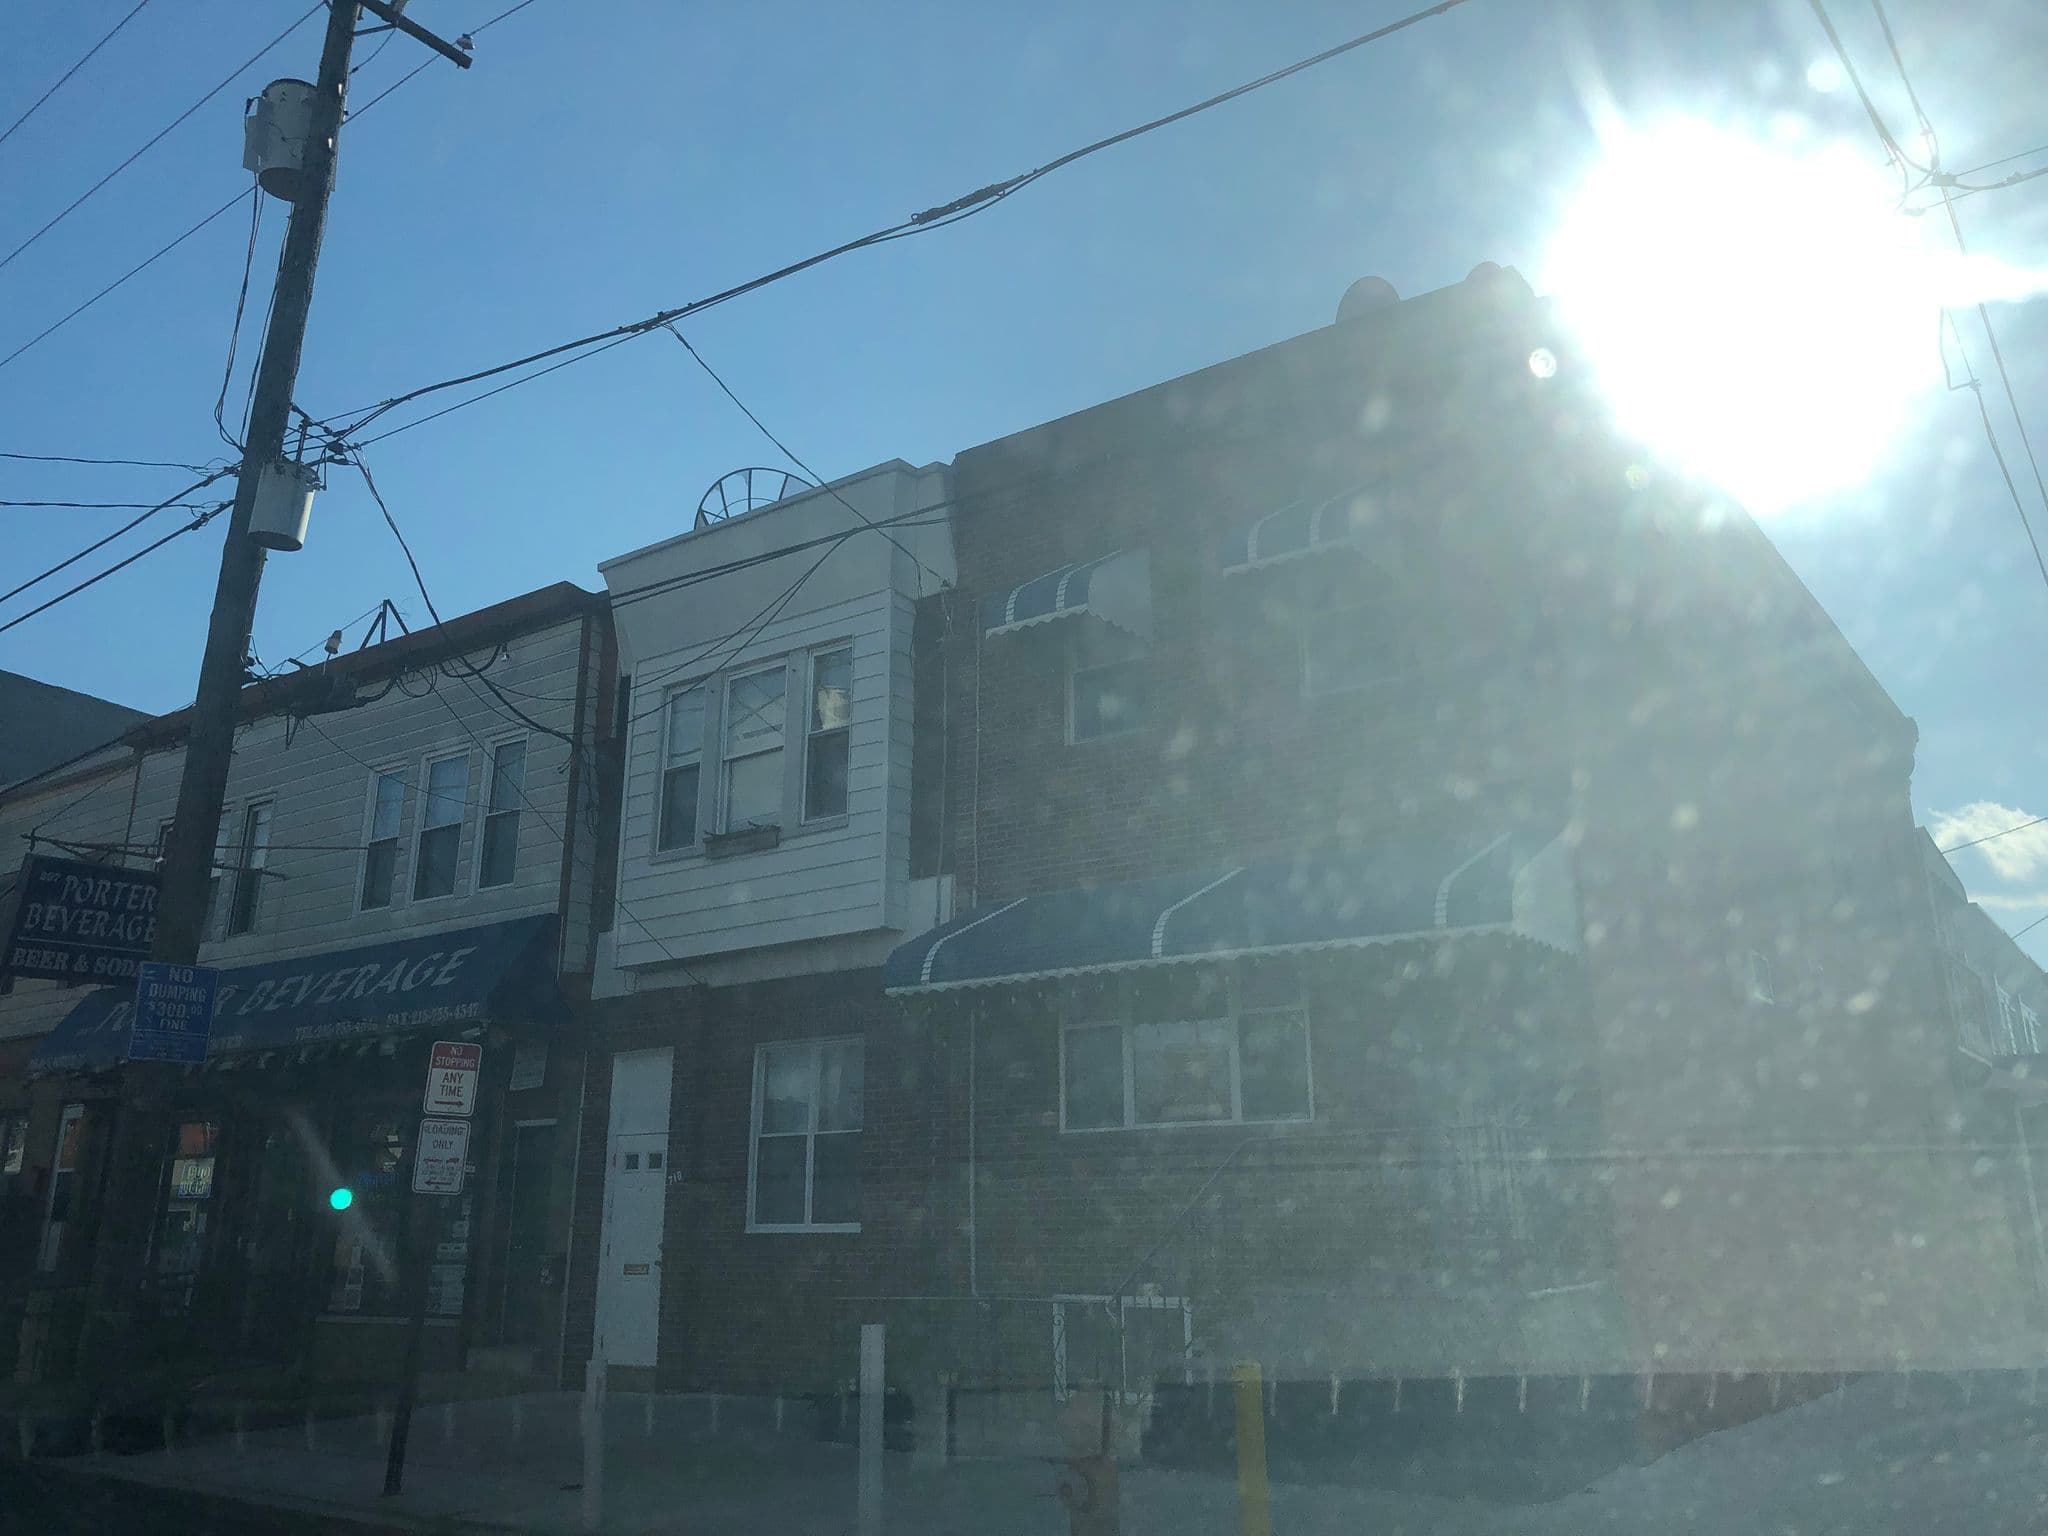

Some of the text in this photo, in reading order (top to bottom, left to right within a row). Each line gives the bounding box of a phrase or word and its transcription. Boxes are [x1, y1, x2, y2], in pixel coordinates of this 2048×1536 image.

[60, 875, 158, 912] PORTER
[11, 948, 141, 977] BEER & SOD
[169, 967, 194, 984] NO
[238, 945, 478, 1016] BEVERAGE
[148, 983, 207, 1002] DUMPING
[160, 1017, 186, 1031] FINE
[450, 1046, 463, 1056] NO
[435, 1057, 476, 1069] STOPPING
[442, 1072, 464, 1084] ANY
[440, 1085, 464, 1098] TIME
[432, 1139, 454, 1150] ONLY
